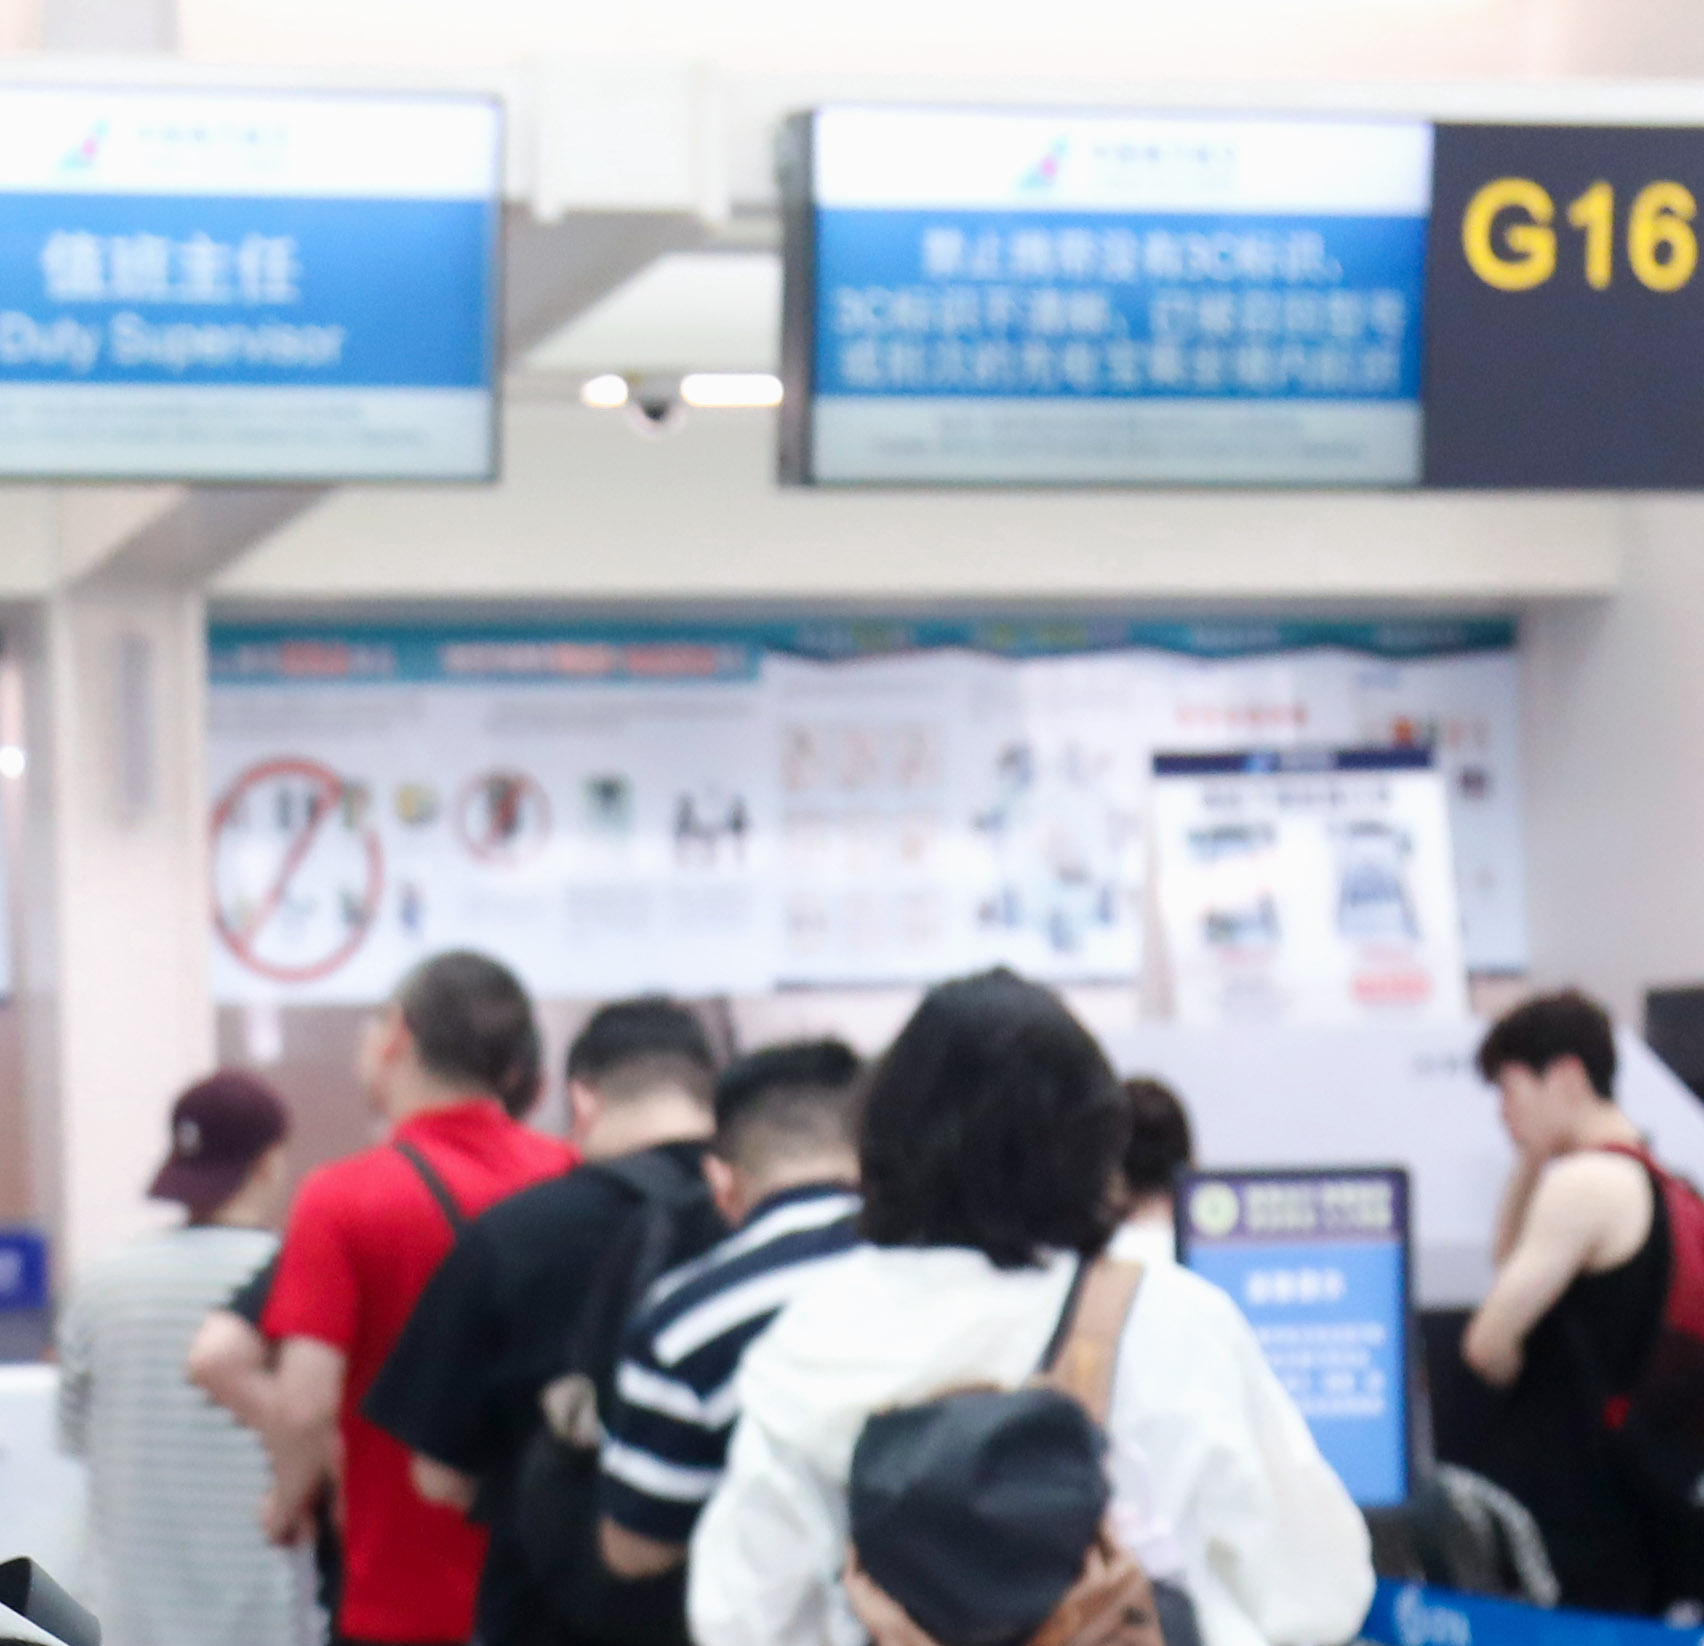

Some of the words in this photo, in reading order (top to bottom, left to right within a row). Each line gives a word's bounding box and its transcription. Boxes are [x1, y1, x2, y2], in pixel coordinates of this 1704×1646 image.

[42, 230, 302, 304] 值班主任
[1461, 176, 1700, 292] G16
[108, 310, 346, 374] Supervisor
